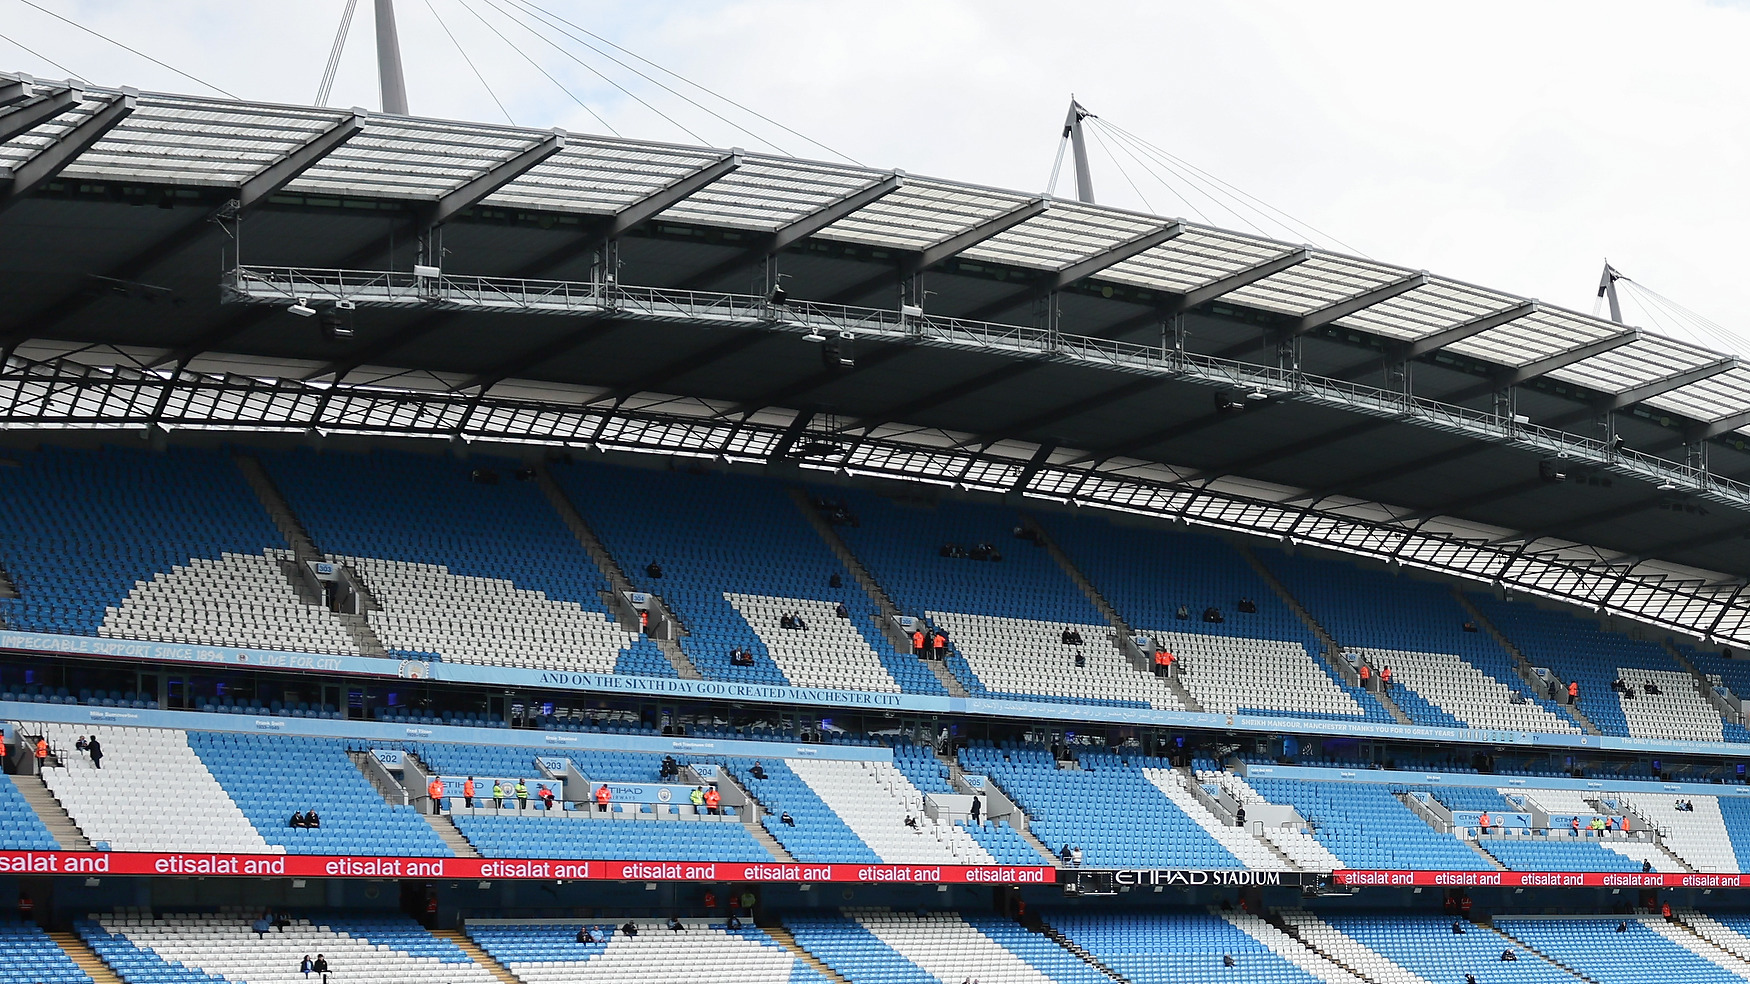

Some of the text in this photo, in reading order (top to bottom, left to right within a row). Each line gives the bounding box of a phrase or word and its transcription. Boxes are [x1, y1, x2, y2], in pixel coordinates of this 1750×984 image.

[2, 635, 225, 662] IMPECCABLE SUPPORT SINCE 1894
[259, 654, 341, 671] LIVE FOR CITY
[540, 673, 901, 706] AND ON THE SIXTH DAY GOD CREATED MANCHESTER CITY
[1241, 718, 1267, 727] SHEIKH
[1303, 722, 1347, 731] MANCHESTER
[1348, 724, 1375, 733] THANKS
[1375, 726, 1389, 734] YOU
[1390, 727, 1403, 735] FOR
[1412, 728, 1436, 736] GREAT
[1436, 729, 1455, 737] YEARS
[1634, 738, 1650, 746] ONLY
[380, 754, 397, 764] 202
[546, 762, 562, 770] 203
[699, 768, 712, 776] 204
[443, 781, 484, 790] ETIHD
[968, 778, 981, 787] 205
[610, 787, 643, 796] TIHAD
[0, 853, 108, 872] salat and
[155, 855, 284, 874] etisalat and
[326, 858, 443, 876] etisalat and
[481, 861, 588, 877] etisalat and
[623, 863, 714, 879] etisalat and
[745, 865, 831, 880] etisalat and
[859, 866, 940, 881] etisalat and
[966, 868, 1043, 881] etisalat and
[1116, 869, 1280, 886] ETIHAD STADIUM
[1345, 871, 1413, 883] etisalat and
[1435, 872, 1500, 884] etisalat and
[1521, 873, 1583, 885] etisalat and
[1604, 874, 1663, 886] etisalat and
[1683, 875, 1740, 887] etisalat and
